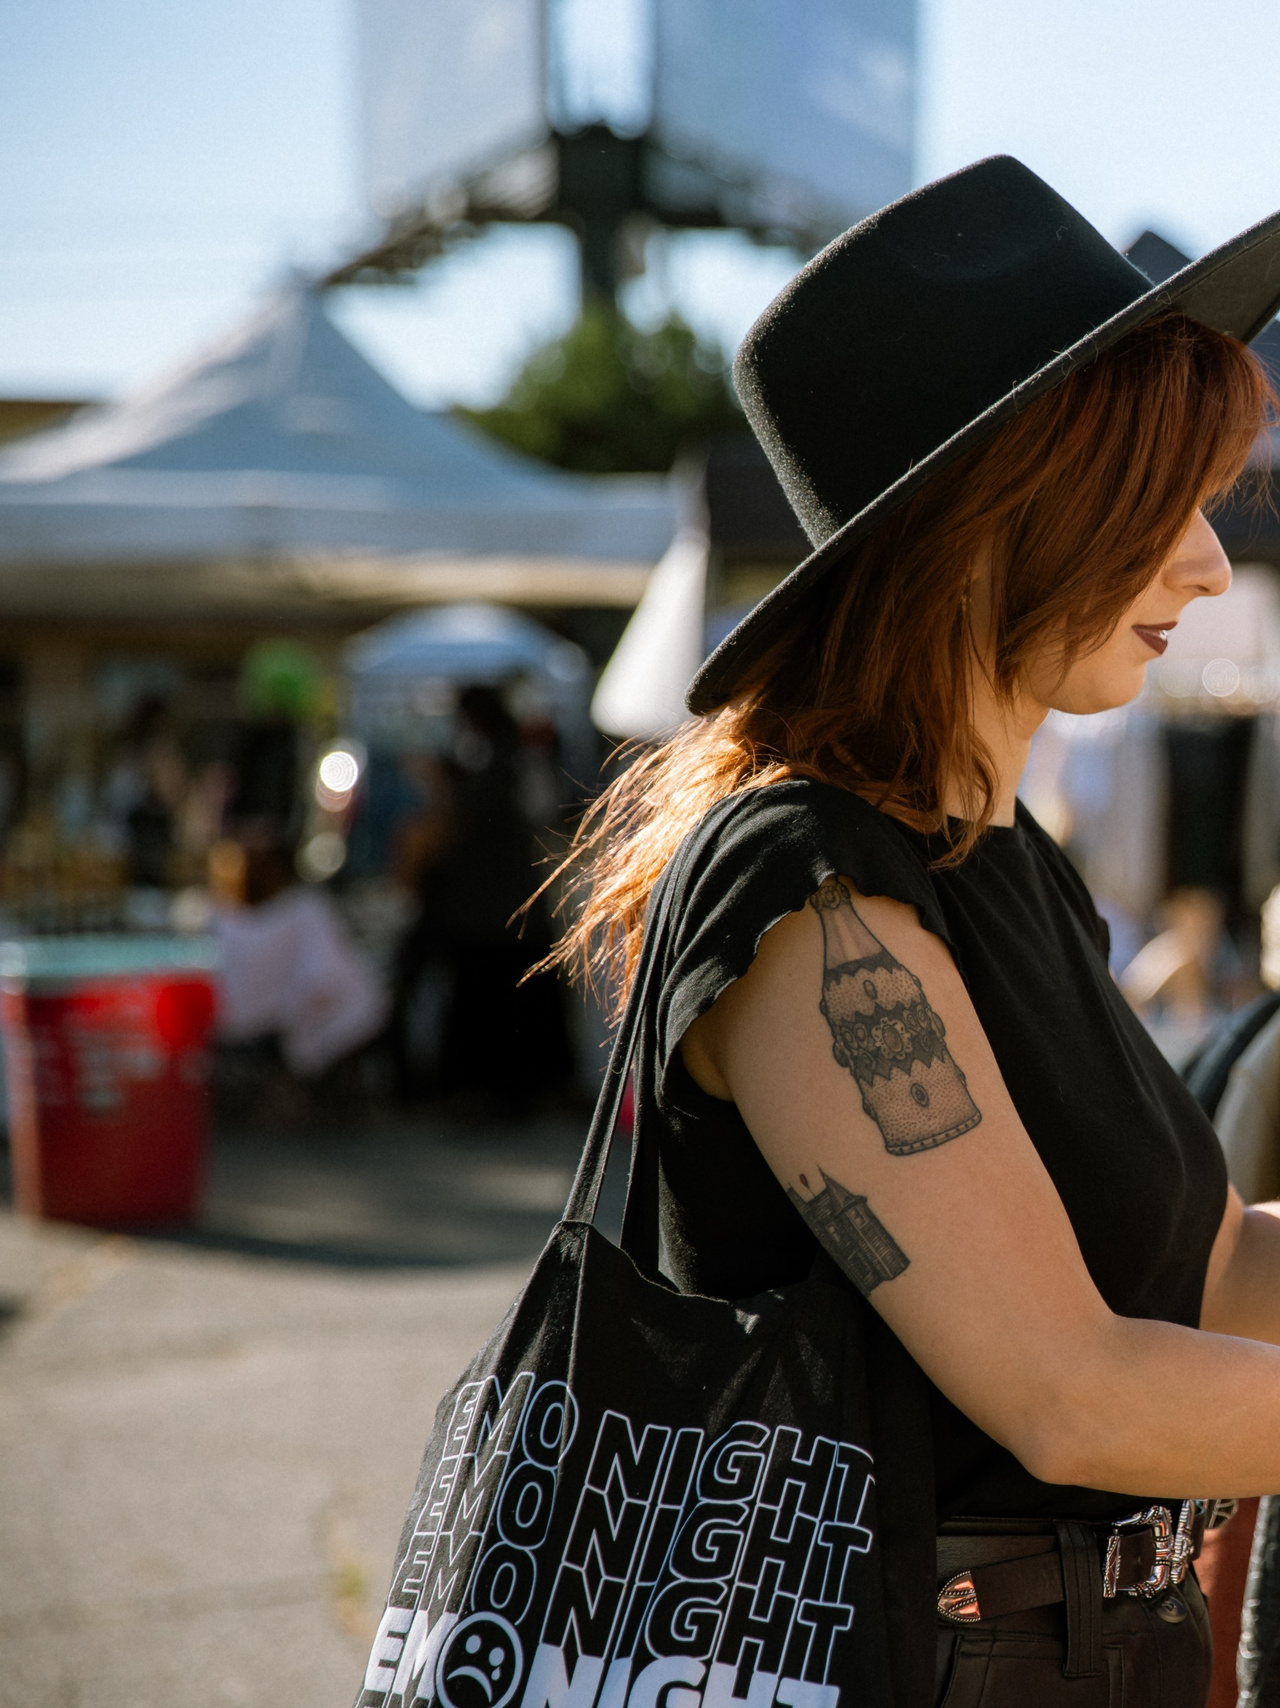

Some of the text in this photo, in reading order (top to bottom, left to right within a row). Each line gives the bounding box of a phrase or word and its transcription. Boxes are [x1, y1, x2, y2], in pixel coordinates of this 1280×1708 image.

[441, 1371, 876, 1527] EMO NIGHT
[414, 1451, 873, 1605] EMO NIGHT
[387, 1531, 854, 1687] EMO NIGHT
